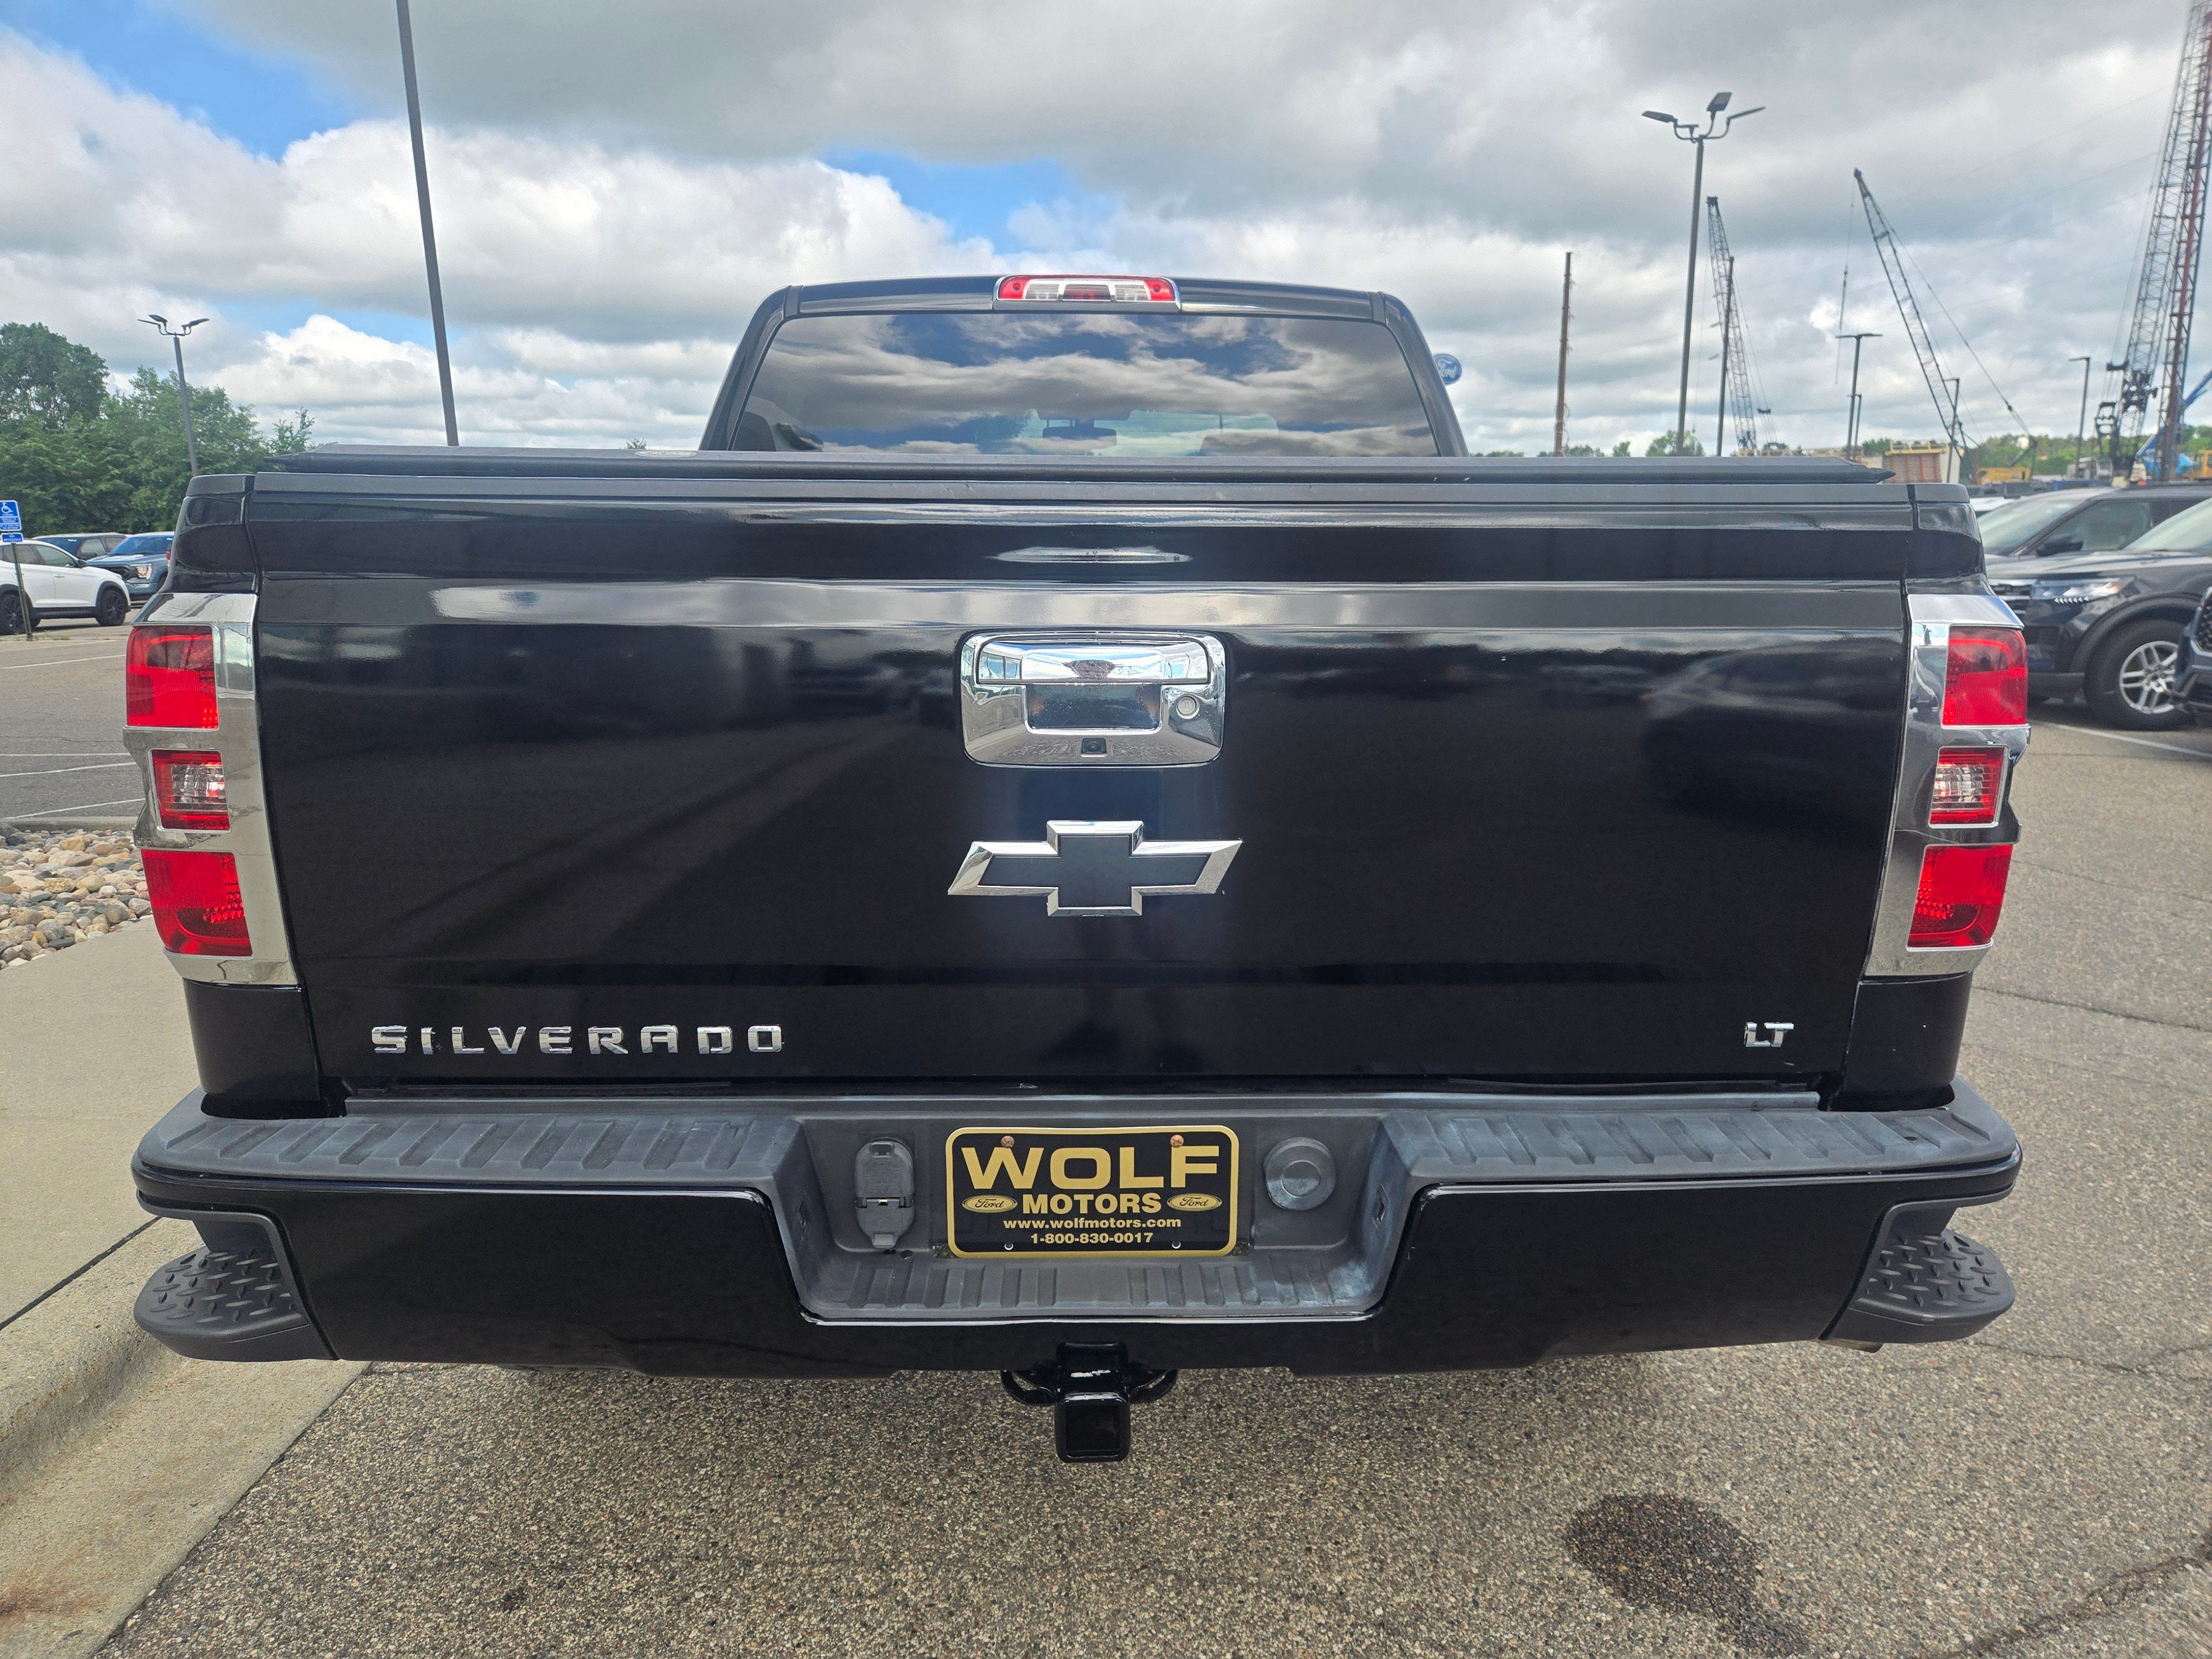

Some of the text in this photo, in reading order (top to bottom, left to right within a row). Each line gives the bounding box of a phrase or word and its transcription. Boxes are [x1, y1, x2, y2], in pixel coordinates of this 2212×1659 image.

[371, 1025, 784, 1055] SILVERADO
[1744, 1022, 1794, 1047] LT
[961, 1145, 1219, 1189] WOLF
[974, 1198, 1004, 1209] Ford
[1022, 1192, 1161, 1214] MOTORS
[1179, 1197, 1209, 1208] Ford
[1003, 1218, 1181, 1229] www.wolfmotors.com
[1030, 1232, 1154, 1244] 1-800-830-0017
